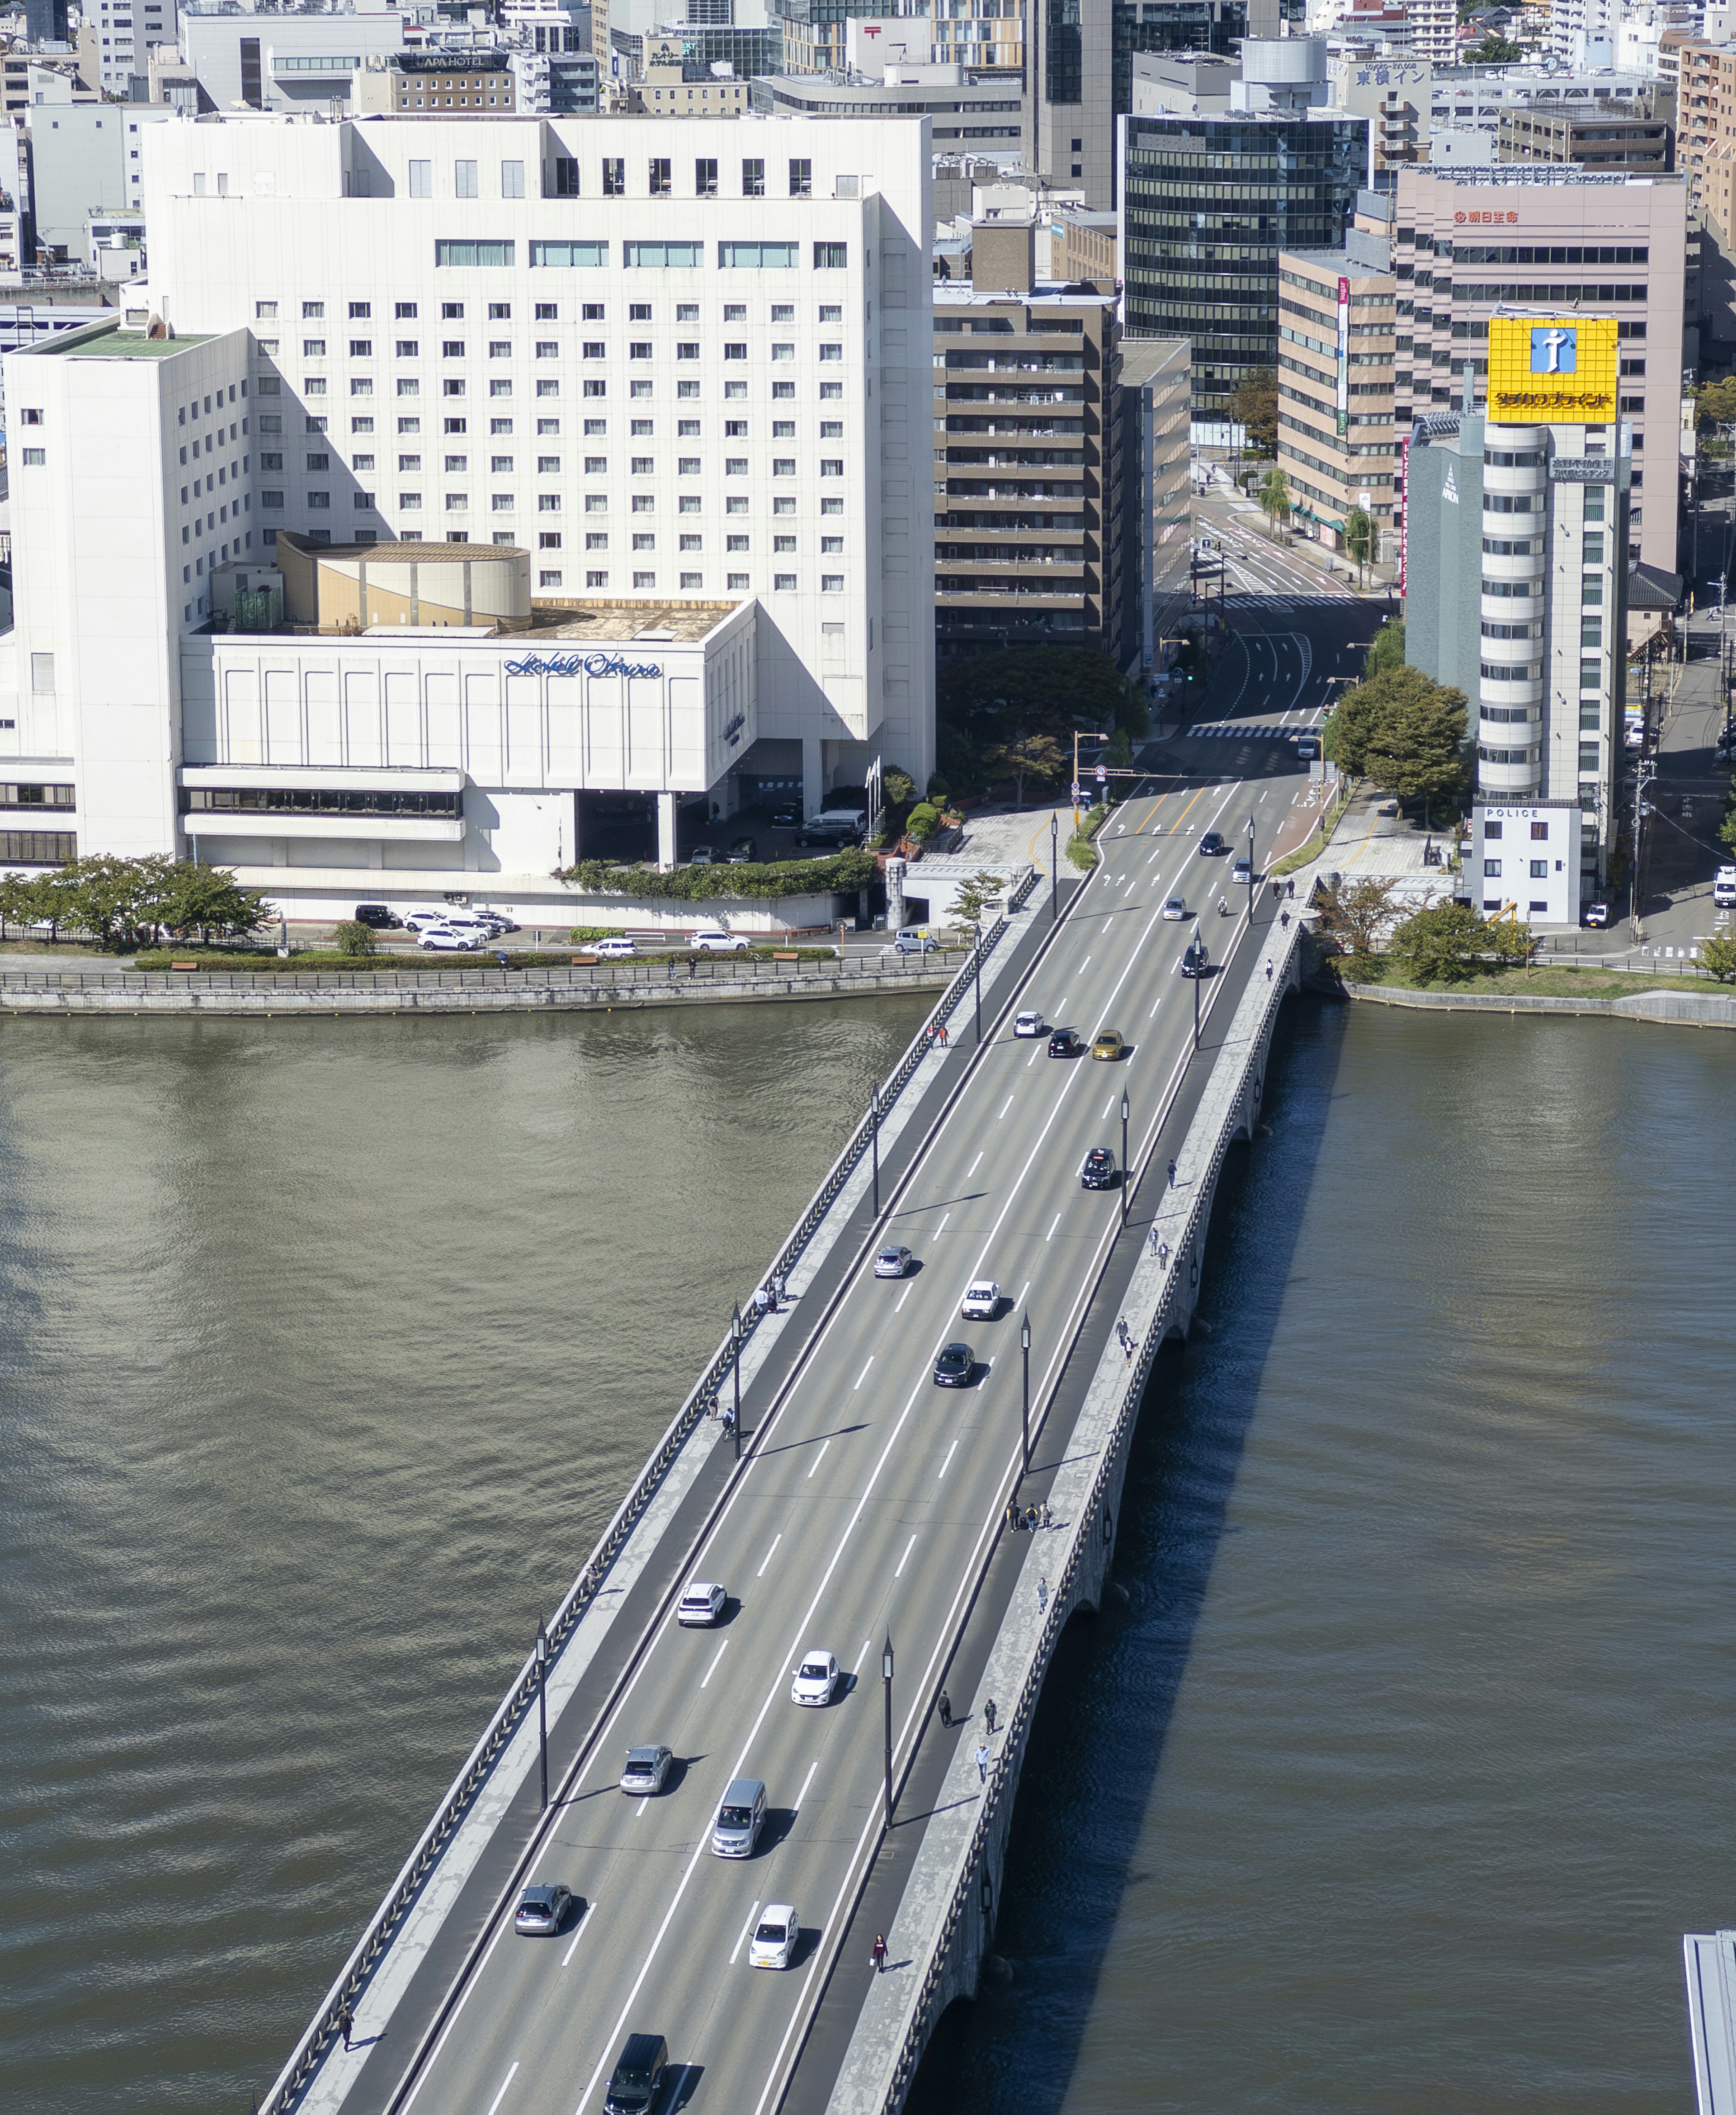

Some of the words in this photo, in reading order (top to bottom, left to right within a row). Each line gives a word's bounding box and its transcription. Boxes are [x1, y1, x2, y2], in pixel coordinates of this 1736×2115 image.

[425, 58, 446, 66] APA
[448, 57, 484, 66] HOTEL
[1356, 70, 1424, 85] 東横イン
[1468, 211, 1519, 223] 朝日生命
[504, 652, 580, 673] Hotel
[584, 653, 661, 674] Okura
[1487, 809, 1538, 817] POLICE
